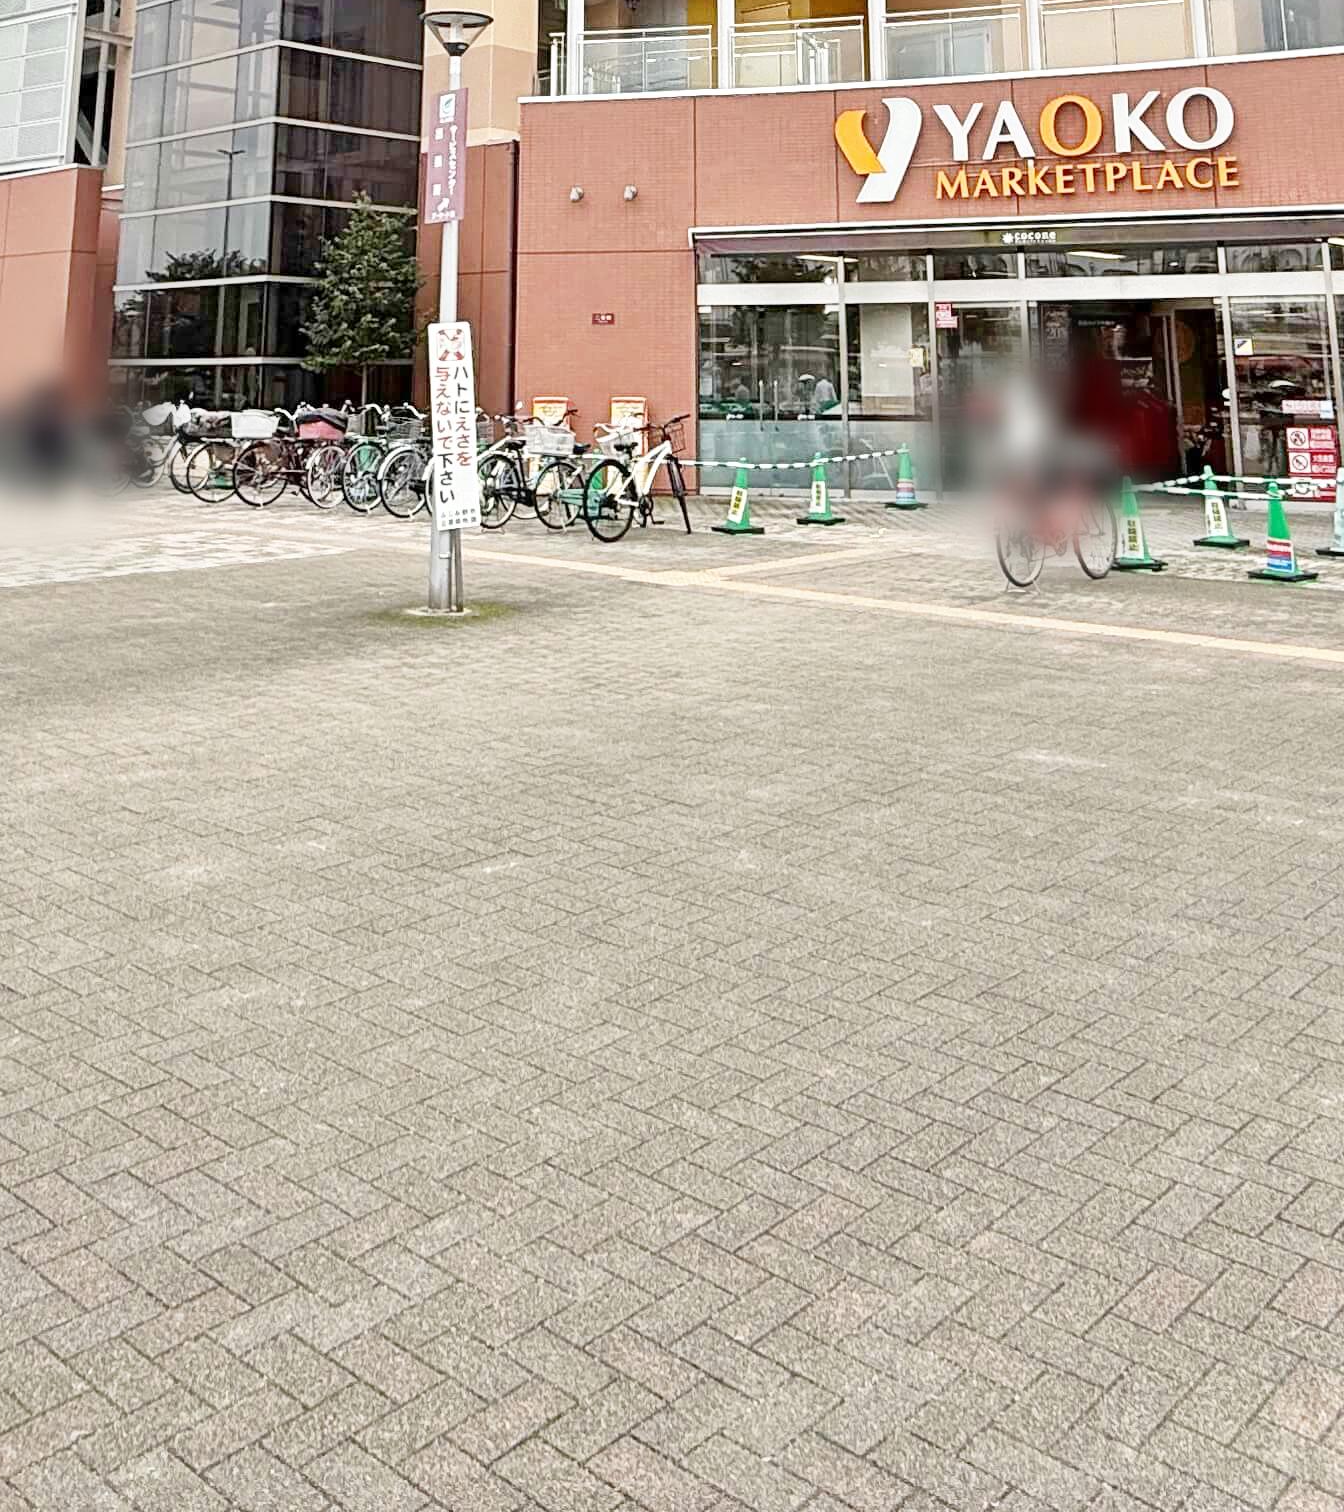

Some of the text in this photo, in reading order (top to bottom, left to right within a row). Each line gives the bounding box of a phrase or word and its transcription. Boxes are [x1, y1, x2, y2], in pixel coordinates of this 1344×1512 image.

[933, 86, 1236, 162] YAOKO
[936, 156, 1240, 201] MARKETPLACE
[1014, 231, 1057, 240] cocone
[435, 367, 455, 504] 与えないで下さい
[454, 366, 472, 467] ハトにえさを
